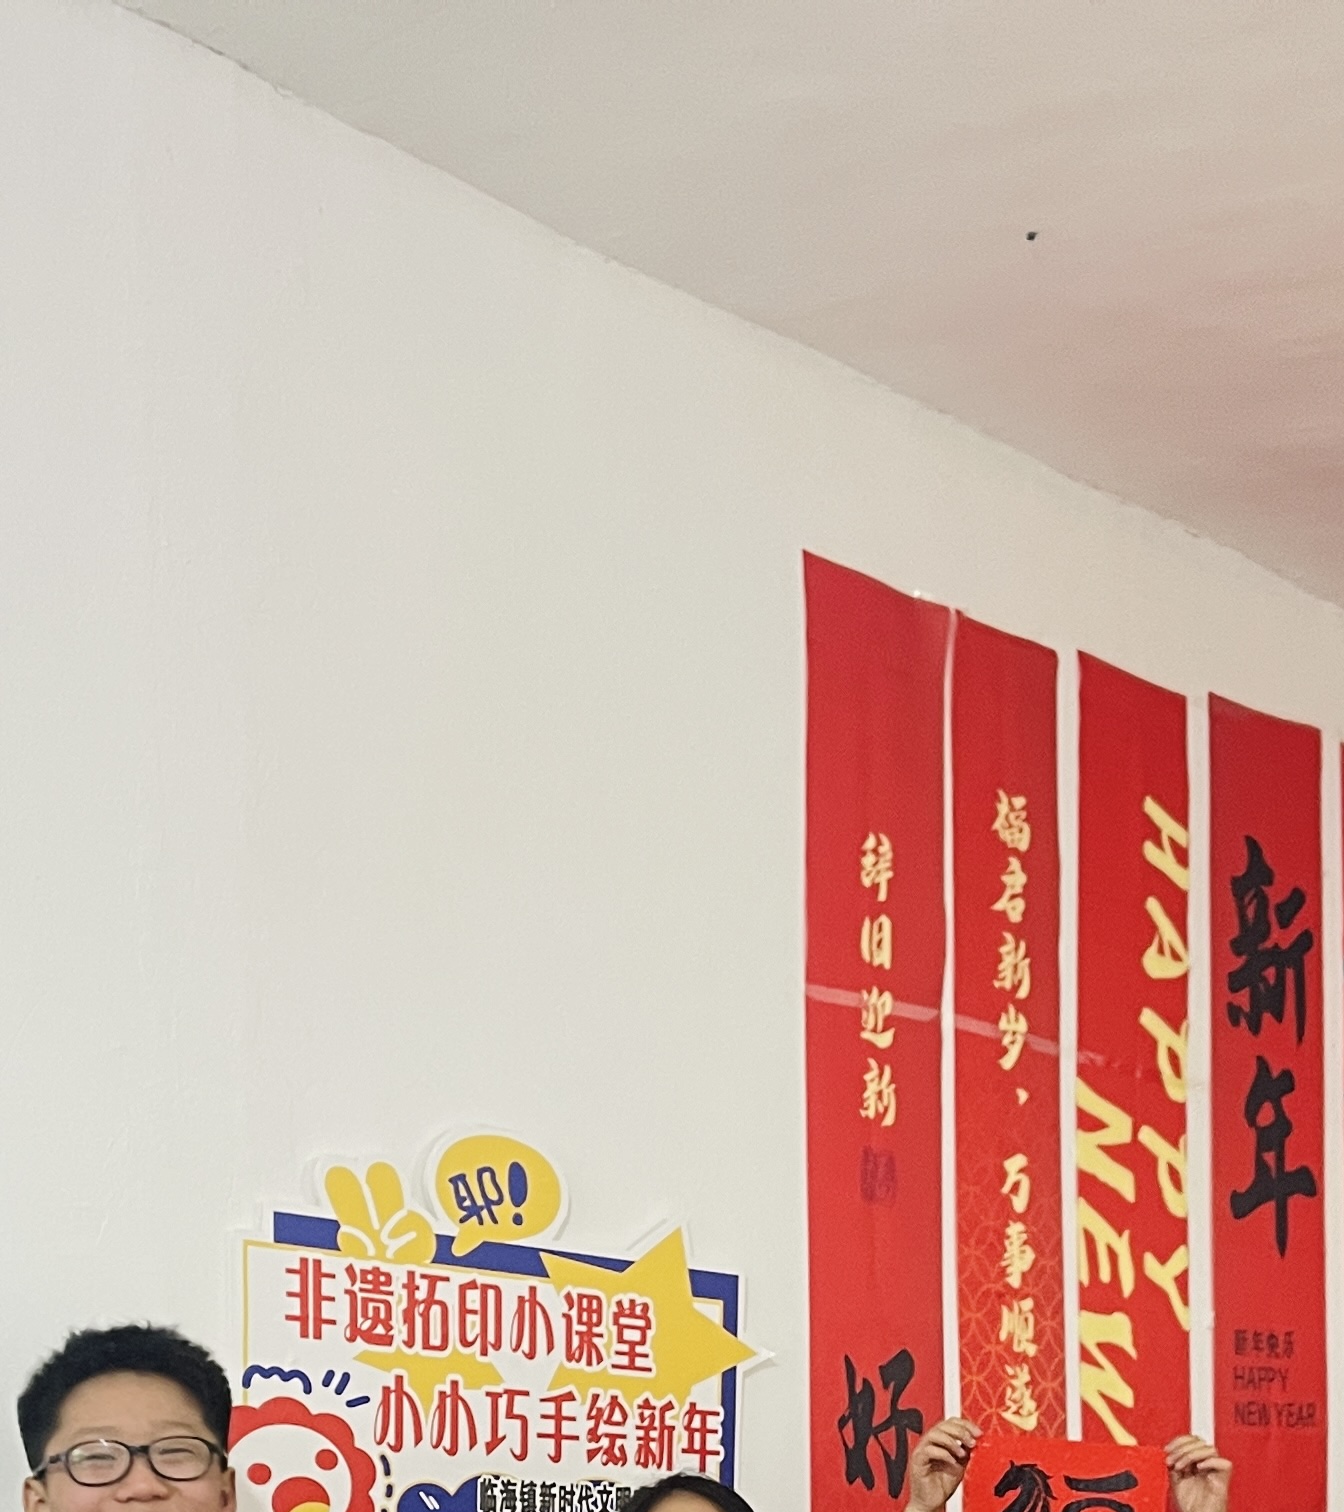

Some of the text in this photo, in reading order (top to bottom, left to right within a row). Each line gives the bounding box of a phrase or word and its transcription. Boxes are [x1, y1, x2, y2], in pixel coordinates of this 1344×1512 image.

[859, 832, 896, 1127] 辞旧迎新
[1227, 835, 1317, 1259] 新年
[284, 1256, 654, 1376] 非遗拓印小课堂
[1233, 1366, 1289, 1392] HAPPY
[374, 1374, 722, 1474] 小小巧手绘新年
[837, 1347, 924, 1499] 好
